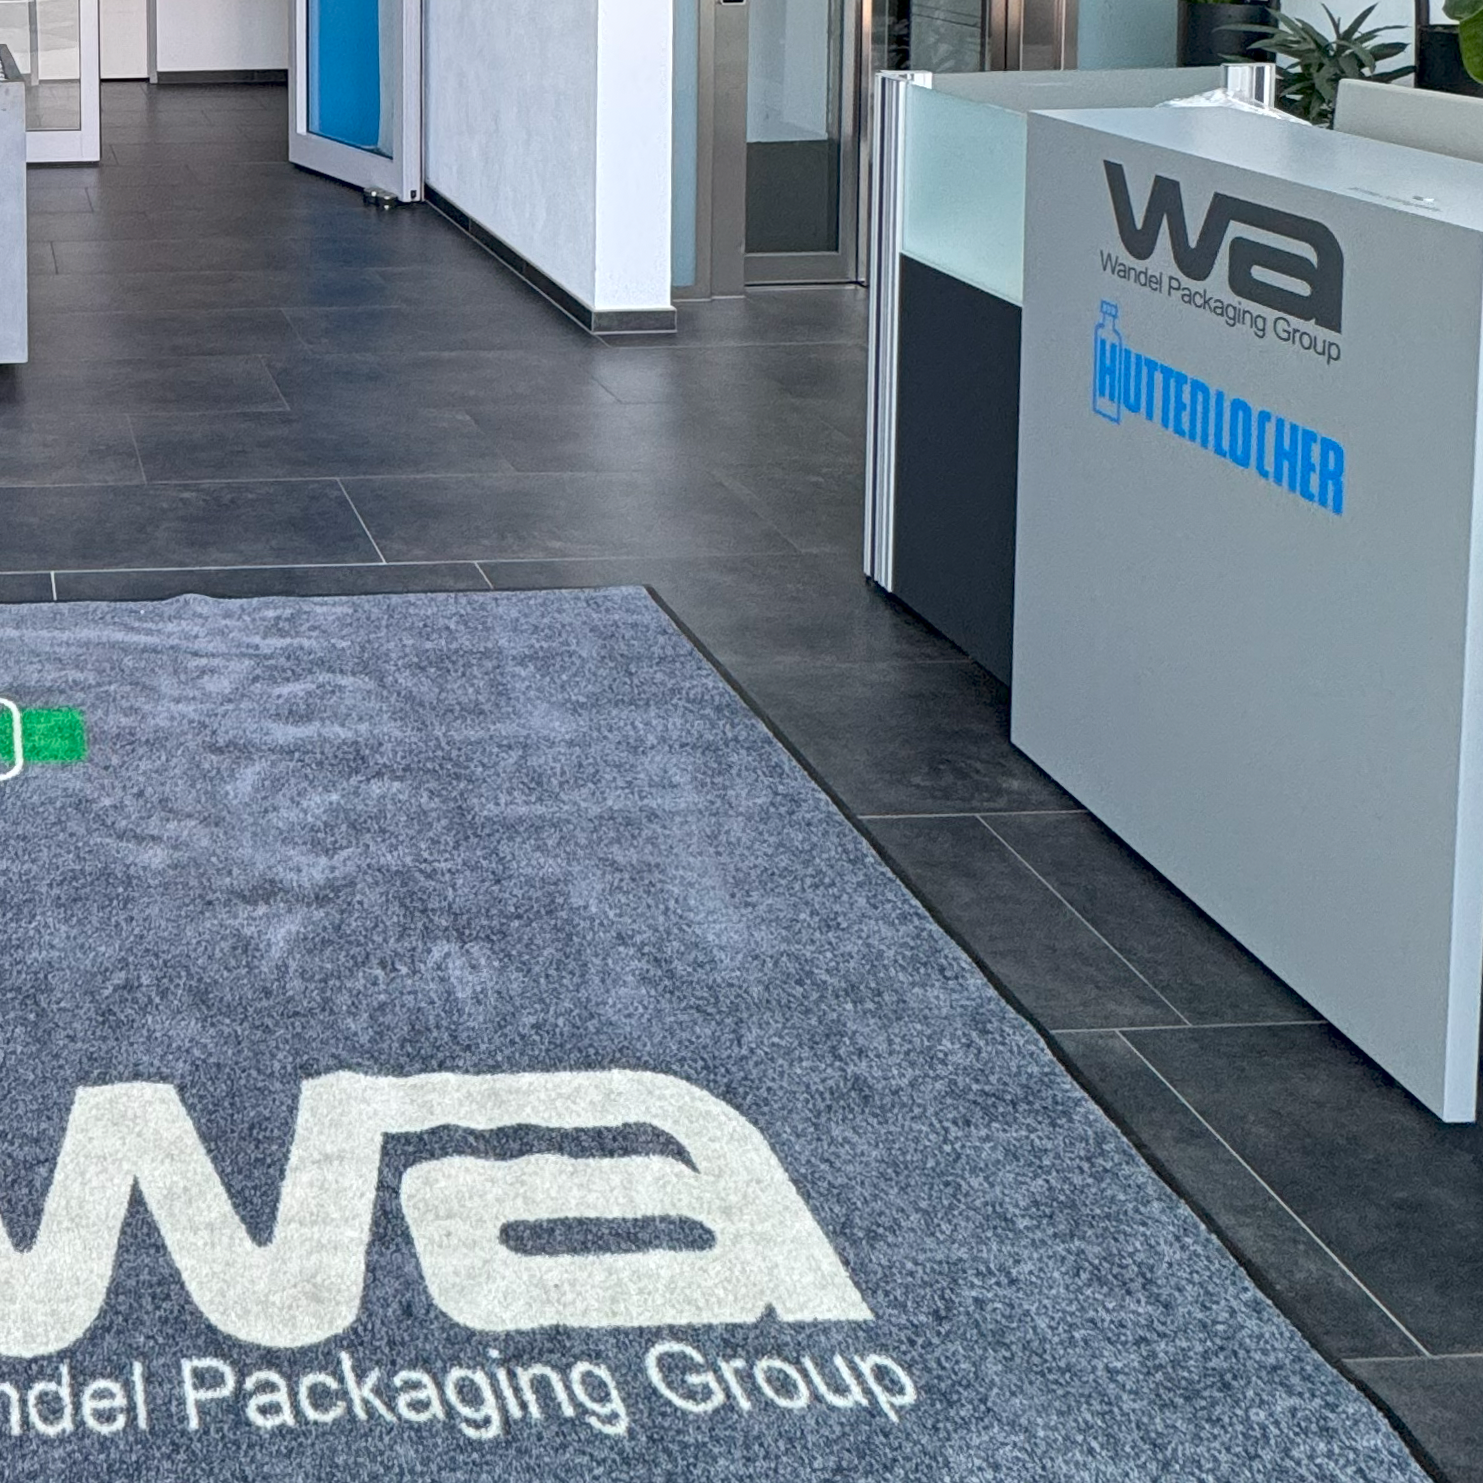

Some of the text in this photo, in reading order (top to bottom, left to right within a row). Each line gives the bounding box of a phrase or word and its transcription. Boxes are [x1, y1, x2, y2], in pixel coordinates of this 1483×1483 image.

[1099, 249, 1341, 365] Wandel Packaging Group
[1097, 337, 1344, 515] HUTTENLOCHER
[181, 1348, 628, 1440] Packaging
[645, 1339, 916, 1423] Group
